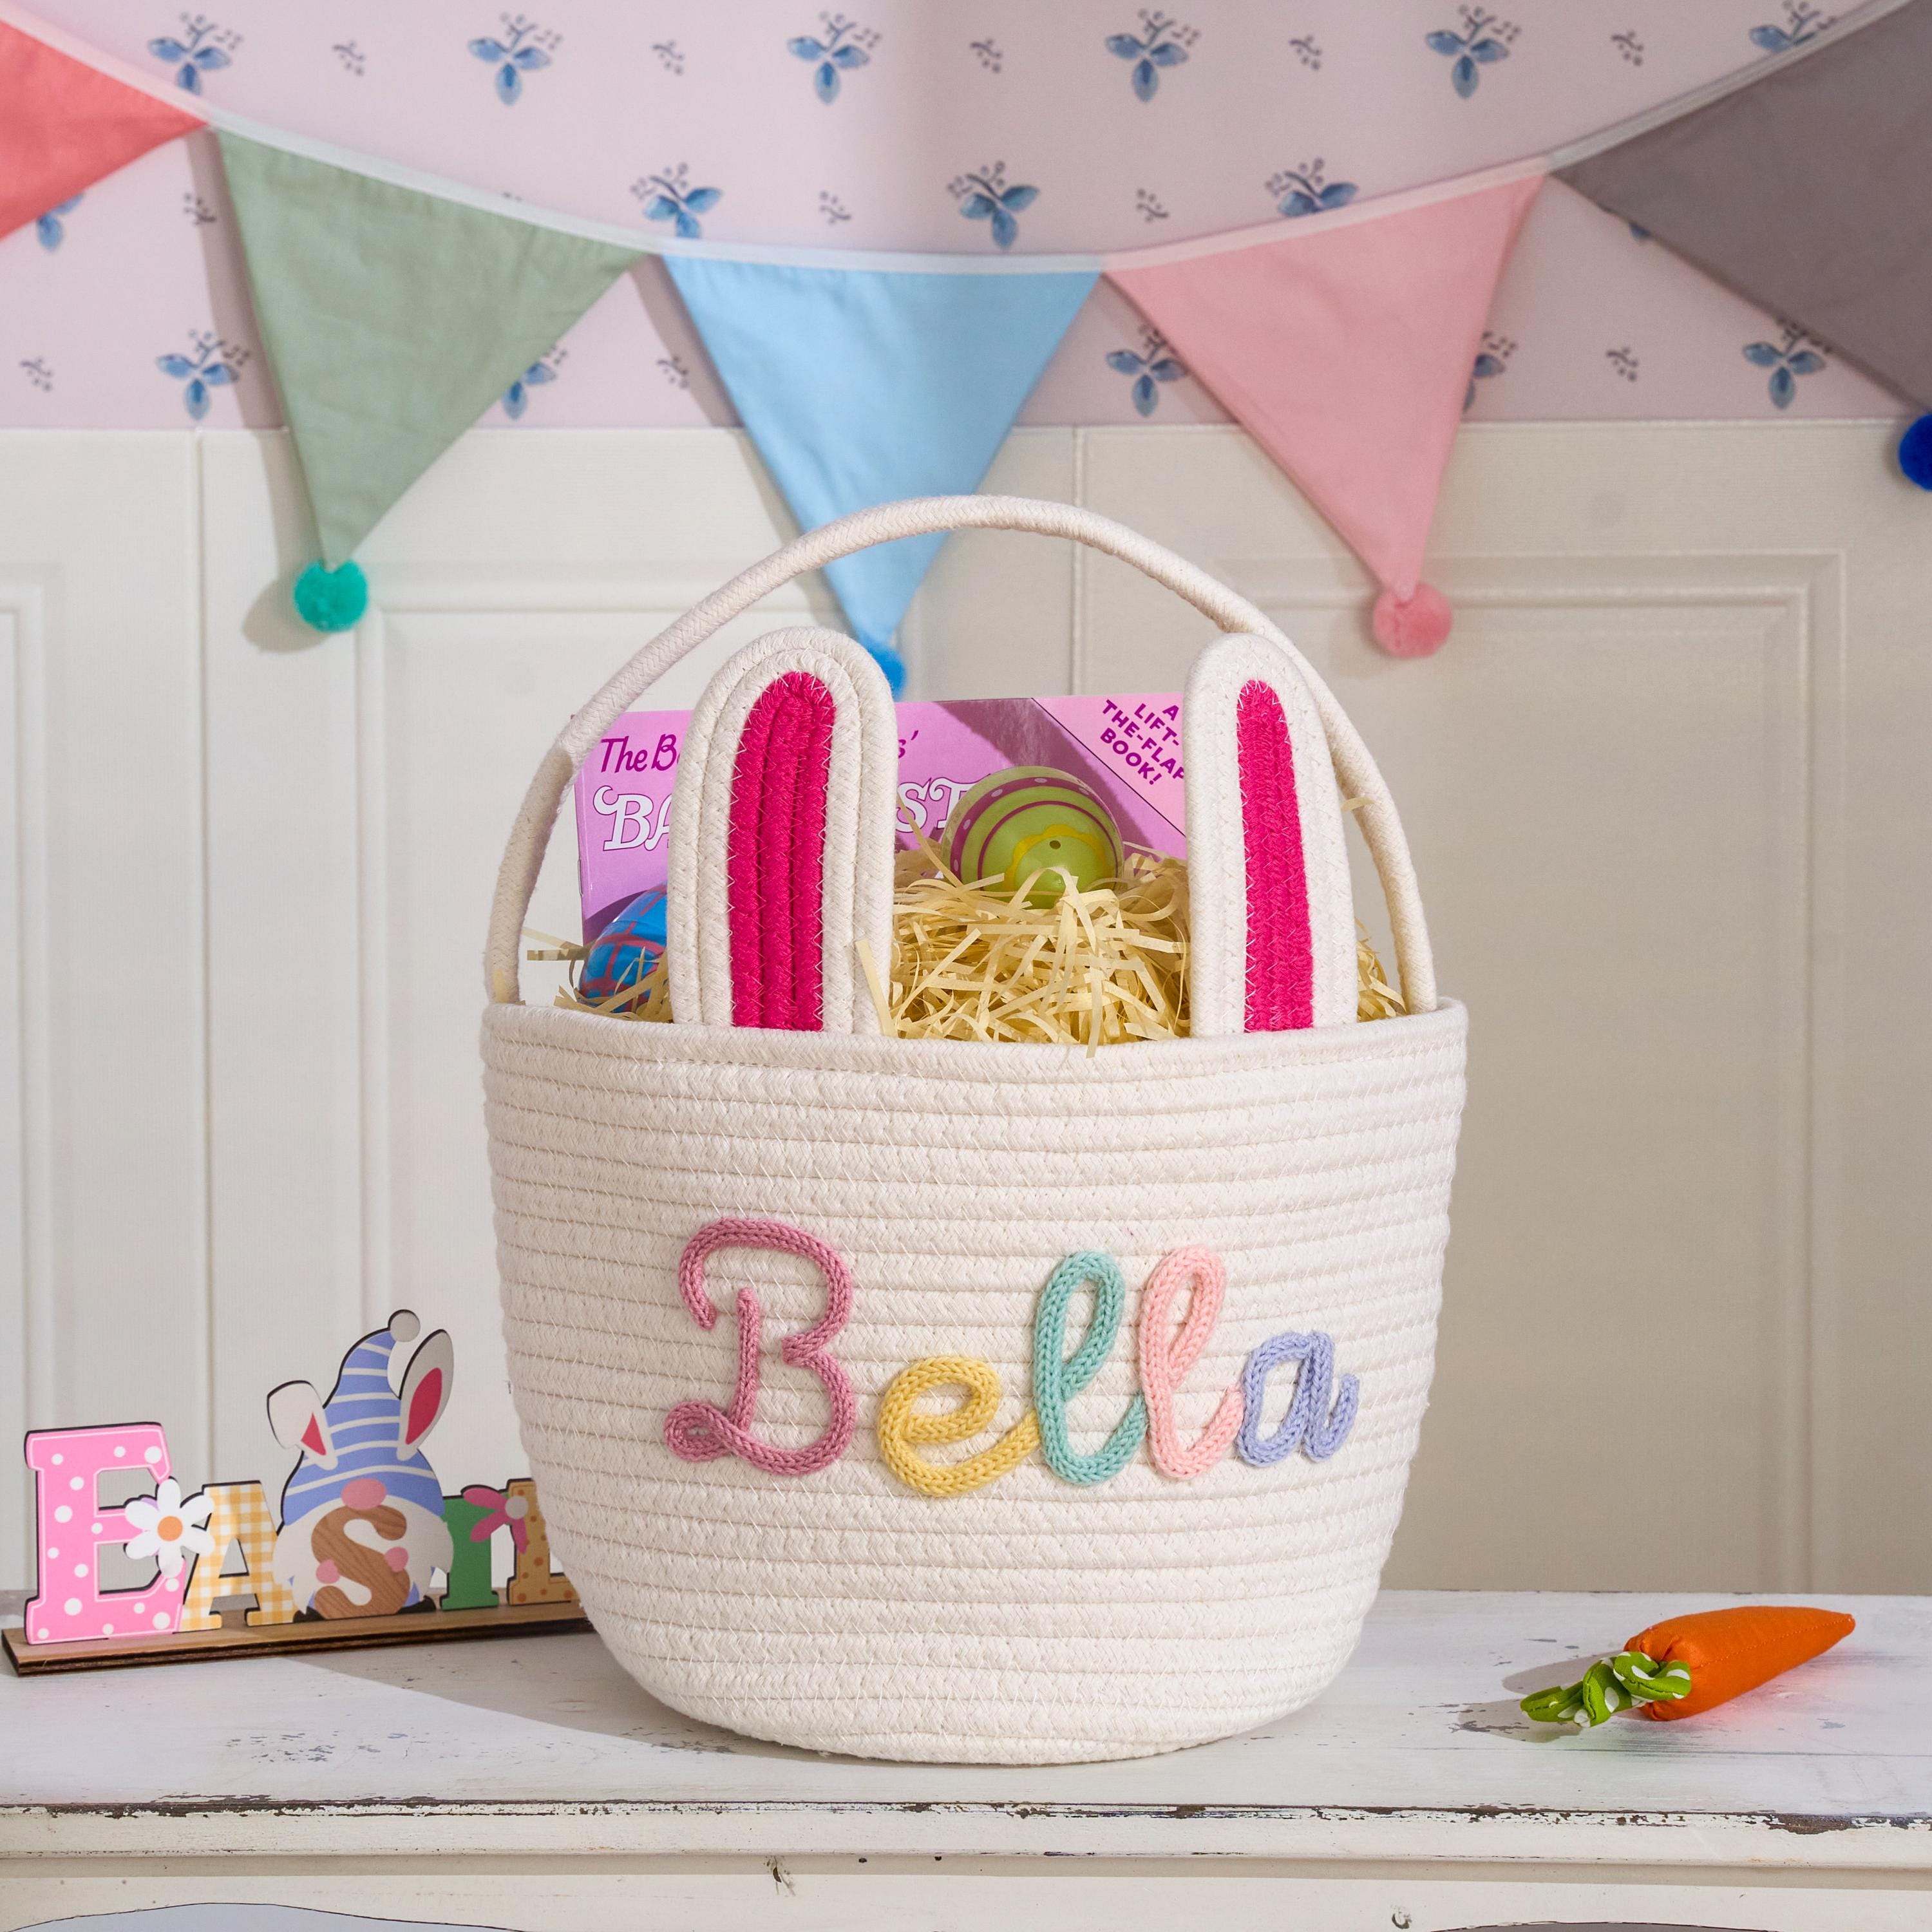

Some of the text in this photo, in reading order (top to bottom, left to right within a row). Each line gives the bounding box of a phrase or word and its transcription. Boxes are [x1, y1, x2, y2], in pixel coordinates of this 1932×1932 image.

[1134, 703, 1179, 746] LIFT-
[1162, 705, 1179, 721] A
[600, 735, 648, 773] The
[1100, 727, 1162, 785] BOOK!
[662, 1215, 1360, 1499] Bella
